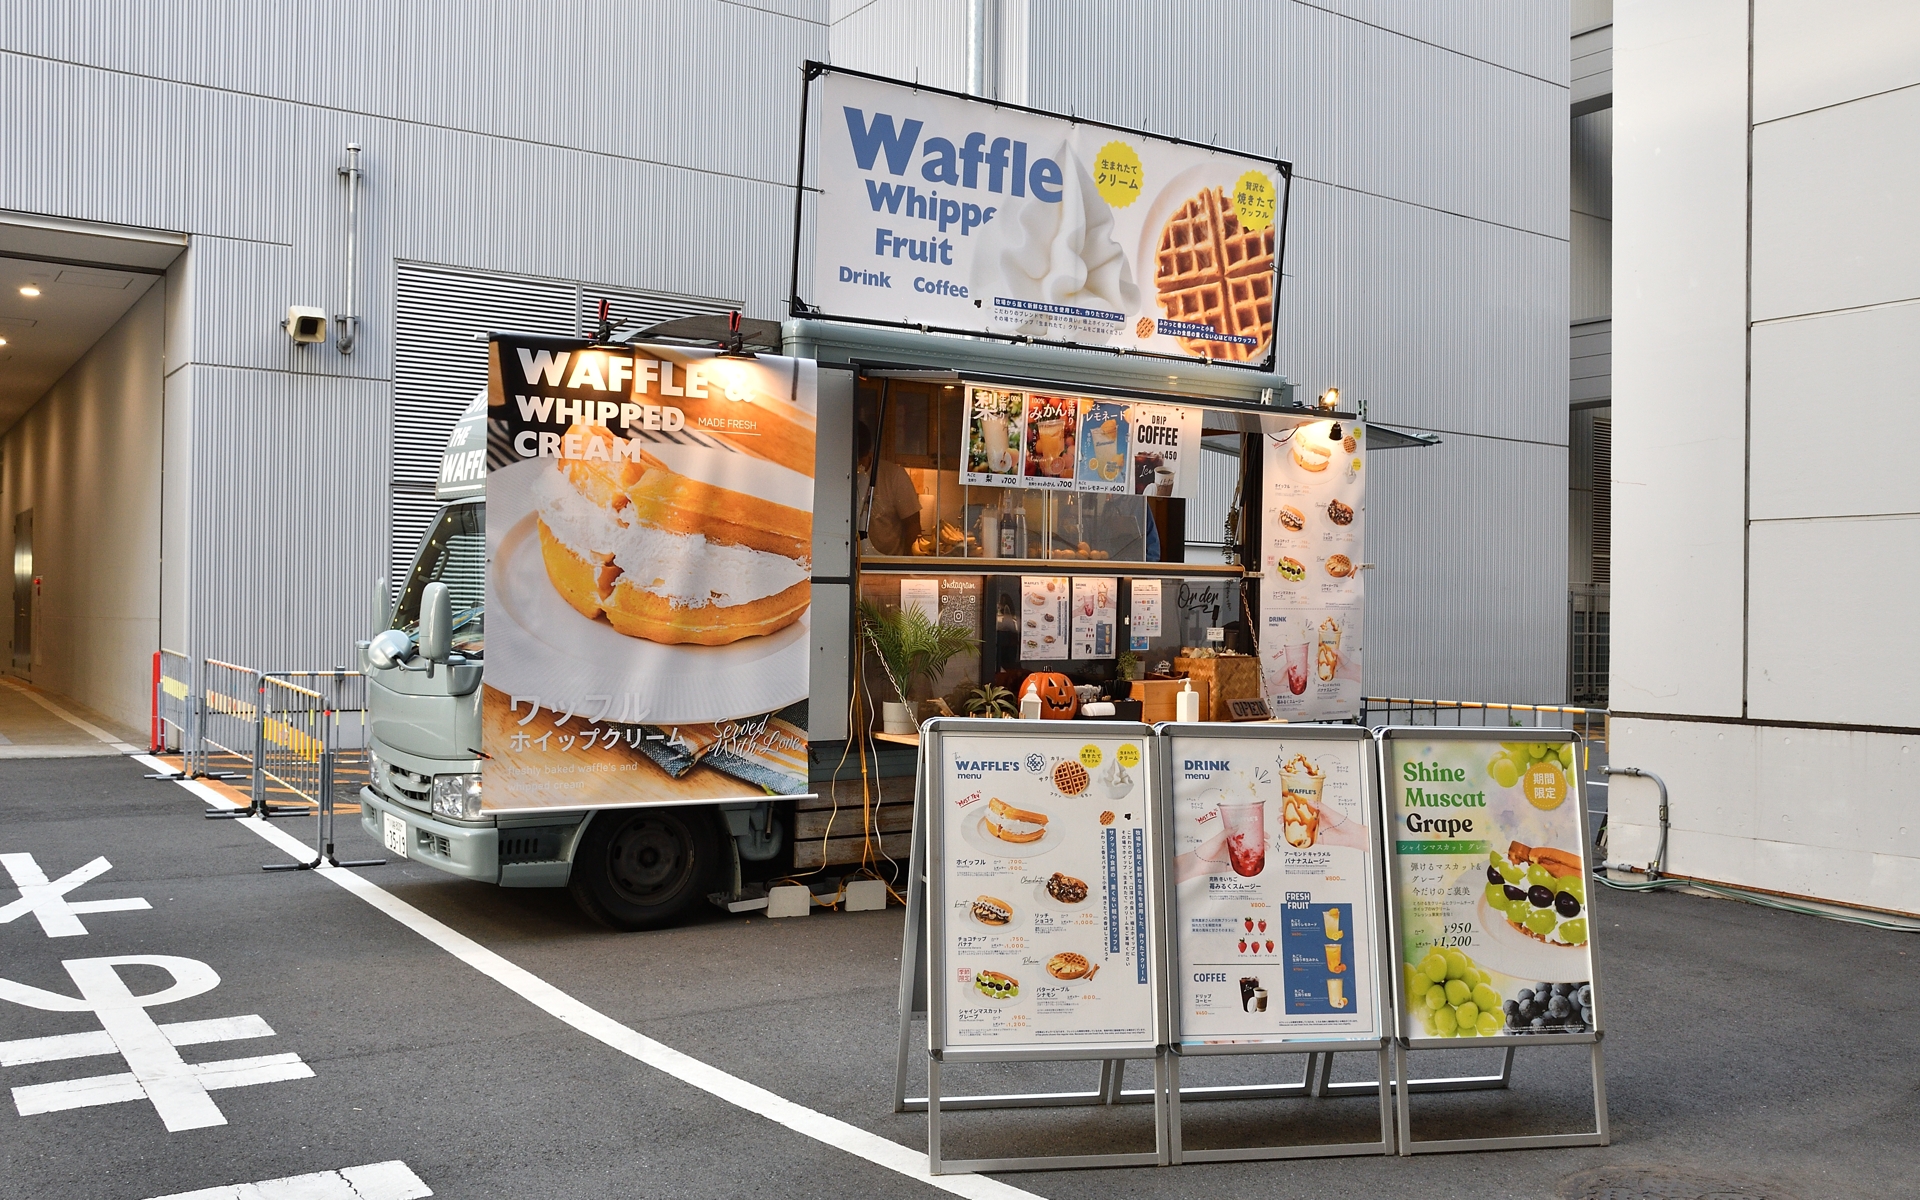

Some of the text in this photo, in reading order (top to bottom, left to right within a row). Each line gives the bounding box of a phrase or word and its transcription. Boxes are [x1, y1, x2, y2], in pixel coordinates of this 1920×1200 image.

[842, 105, 1063, 203] Waffle
[1101, 159, 1138, 175] 生まれたて
[1098, 172, 1139, 190] クリーム
[1245, 180, 1265, 193] 贅沢な
[1237, 192, 1275, 209] 焼きたて
[1240, 207, 1269, 219] ワッフル
[875, 228, 953, 266] Fruit
[838, 265, 969, 298] Drink Coffee
[517, 348, 755, 403] WAFFLE &
[973, 391, 998, 420] 梨
[1030, 402, 1067, 420] みかん
[1067, 400, 1075, 426] 生搾り
[516, 396, 685, 432] WHIPPED
[1087, 411, 1126, 421] レモネード
[1152, 415, 1166, 425] DRIP
[698, 417, 757, 430] MADE FRESH
[449, 426, 472, 447] THE
[1138, 424, 1178, 446] COFFEE
[513, 431, 641, 463] CREAM
[442, 449, 487, 483] WAFFL
[1139, 464, 1153, 477] Ice
[1001, 477, 1017, 485] ¥700
[1057, 480, 1072, 488] ¥700
[941, 579, 975, 594] Instagram
[1178, 583, 1219, 608] Order
[510, 691, 651, 726] ワッフル
[1232, 701, 1268, 717] OPEN
[712, 714, 770, 739] Served
[509, 728, 687, 753] ホイップクリーム
[708, 731, 800, 758] With Love
[545, 764, 575, 775] baked
[578, 762, 616, 772] waffle's
[620, 762, 638, 771] and
[955, 761, 1020, 771] WAFFLE'S
[1184, 760, 1230, 771] DRINK
[1403, 762, 1465, 781] Shine
[1533, 772, 1555, 785] 期間
[508, 781, 585, 793] whipped cream
[1534, 787, 1556, 799] 限定
[1405, 788, 1486, 807] Muscat
[1406, 813, 1473, 838] Grape
[1401, 843, 1463, 851] シャインマスカット
[1412, 875, 1444, 883] グレープ
[1286, 893, 1310, 901] FRESH
[1413, 887, 1470, 896] 今だけのご褒美
[1444, 922, 1472, 934] ¥950
[1434, 936, 1472, 948] ¥1,200
[1193, 973, 1226, 982] COFFEE
